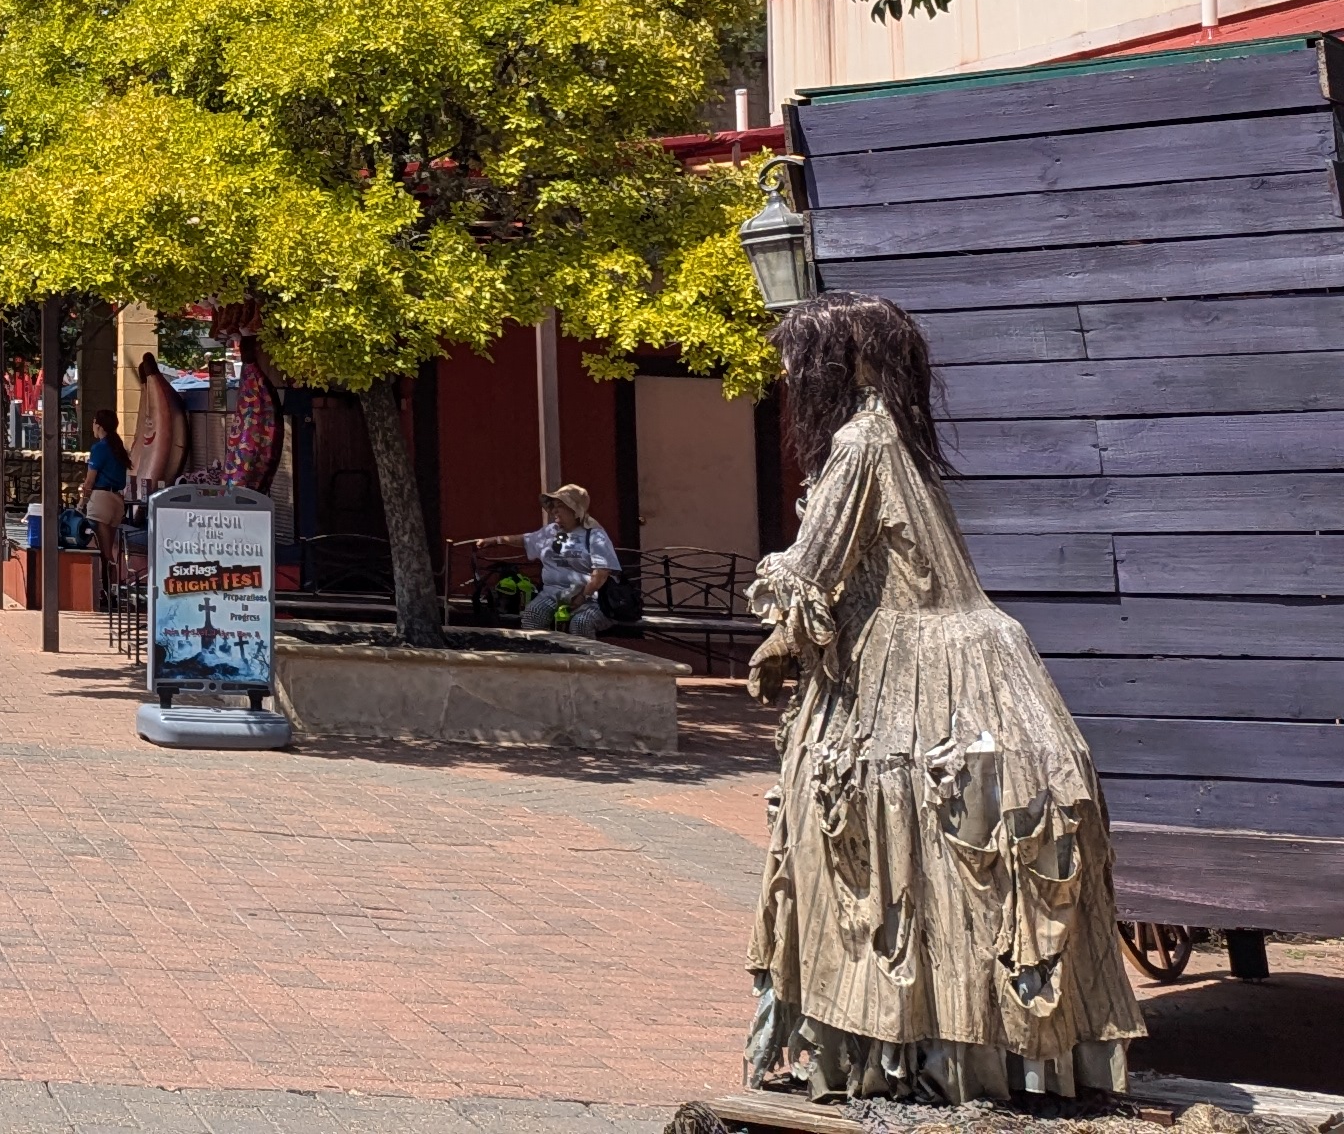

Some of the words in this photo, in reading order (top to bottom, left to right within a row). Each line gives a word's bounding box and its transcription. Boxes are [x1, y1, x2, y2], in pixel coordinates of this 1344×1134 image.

[186, 511, 241, 529] Pardon
[204, 527, 224, 540] the
[163, 537, 263, 557] Construction
[168, 577, 219, 593] FRIGHT
[222, 571, 260, 590] FEST
[223, 593, 268, 602] Preparations
[241, 603, 249, 612] in
[230, 612, 261, 623] Progress
